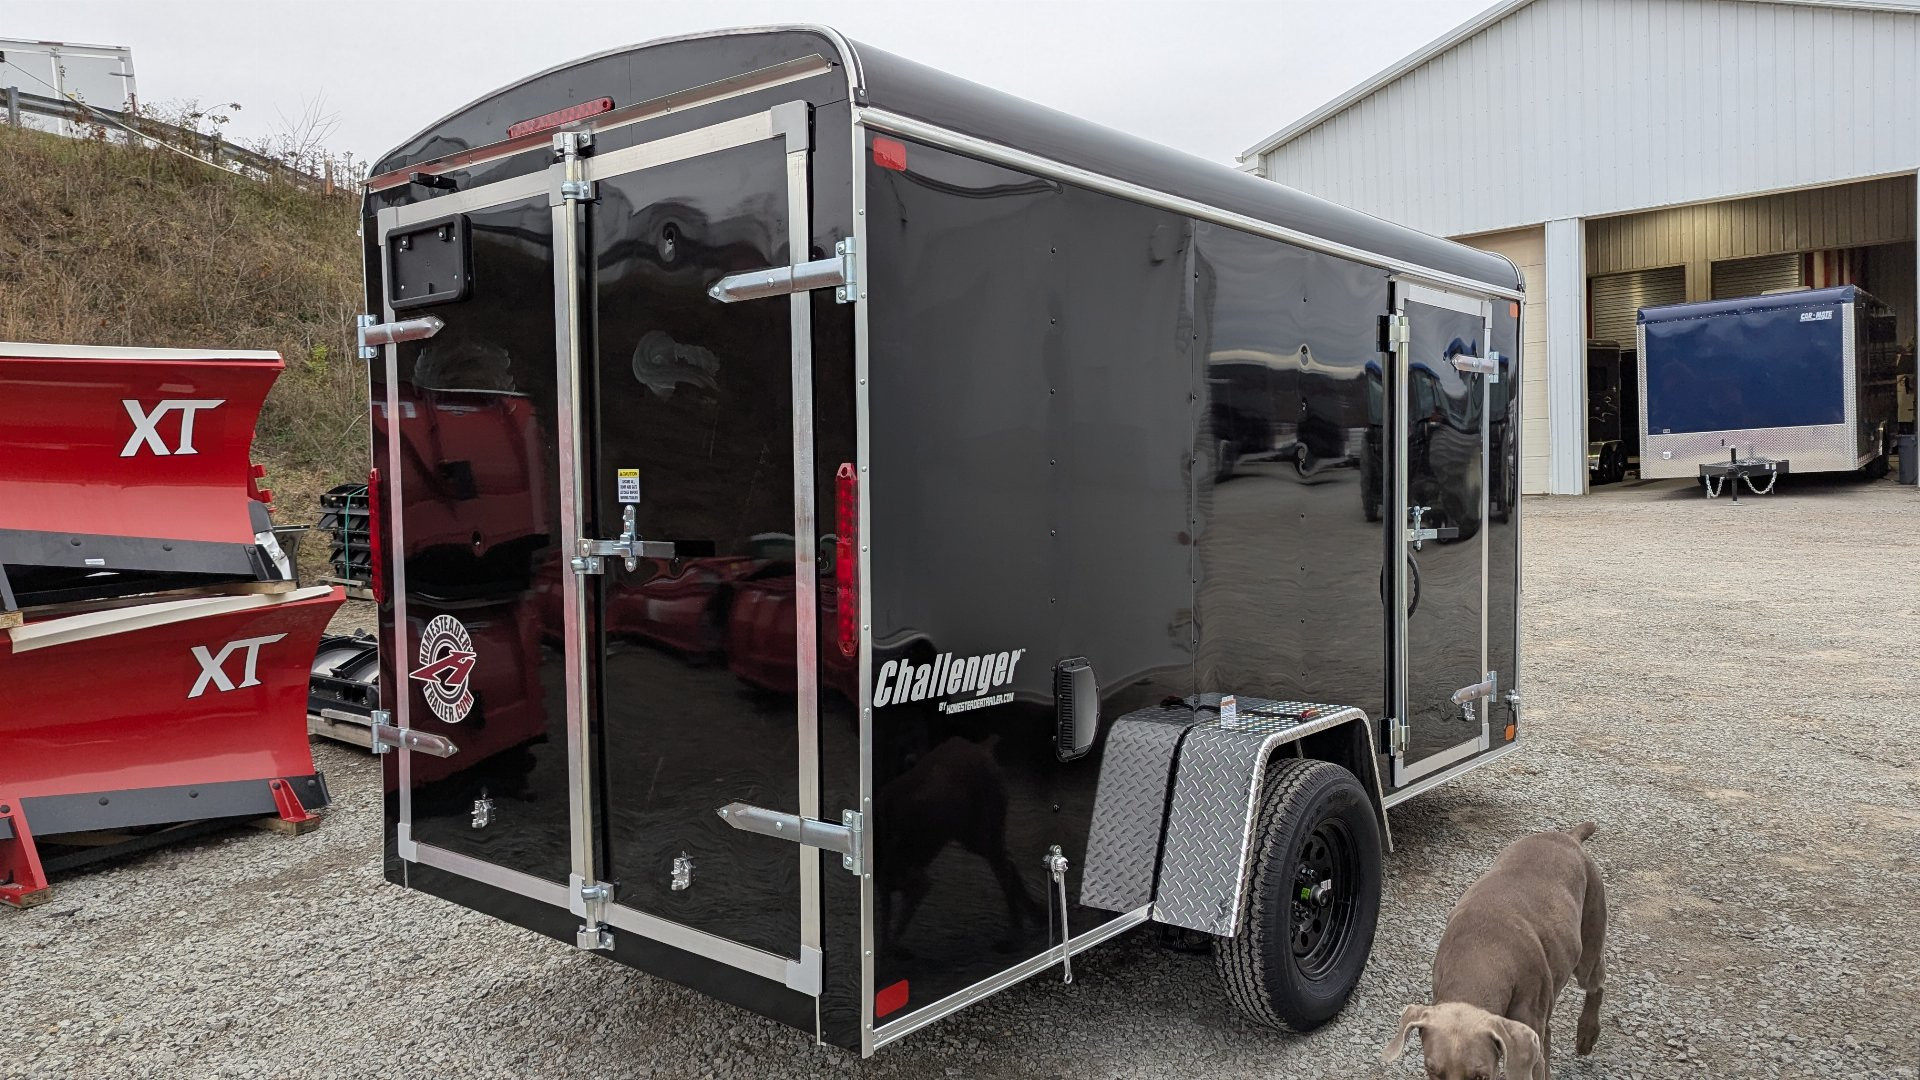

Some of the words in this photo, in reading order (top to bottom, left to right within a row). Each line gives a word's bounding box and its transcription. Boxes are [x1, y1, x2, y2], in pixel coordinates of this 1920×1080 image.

[120, 399, 226, 457] XT
[187, 632, 289, 699] XT
[420, 616, 470, 664] HOMESTEADER
[424, 684, 473, 722] TRAILER.COM
[873, 648, 1022, 708] Challenger
[938, 701, 948, 711] BY
